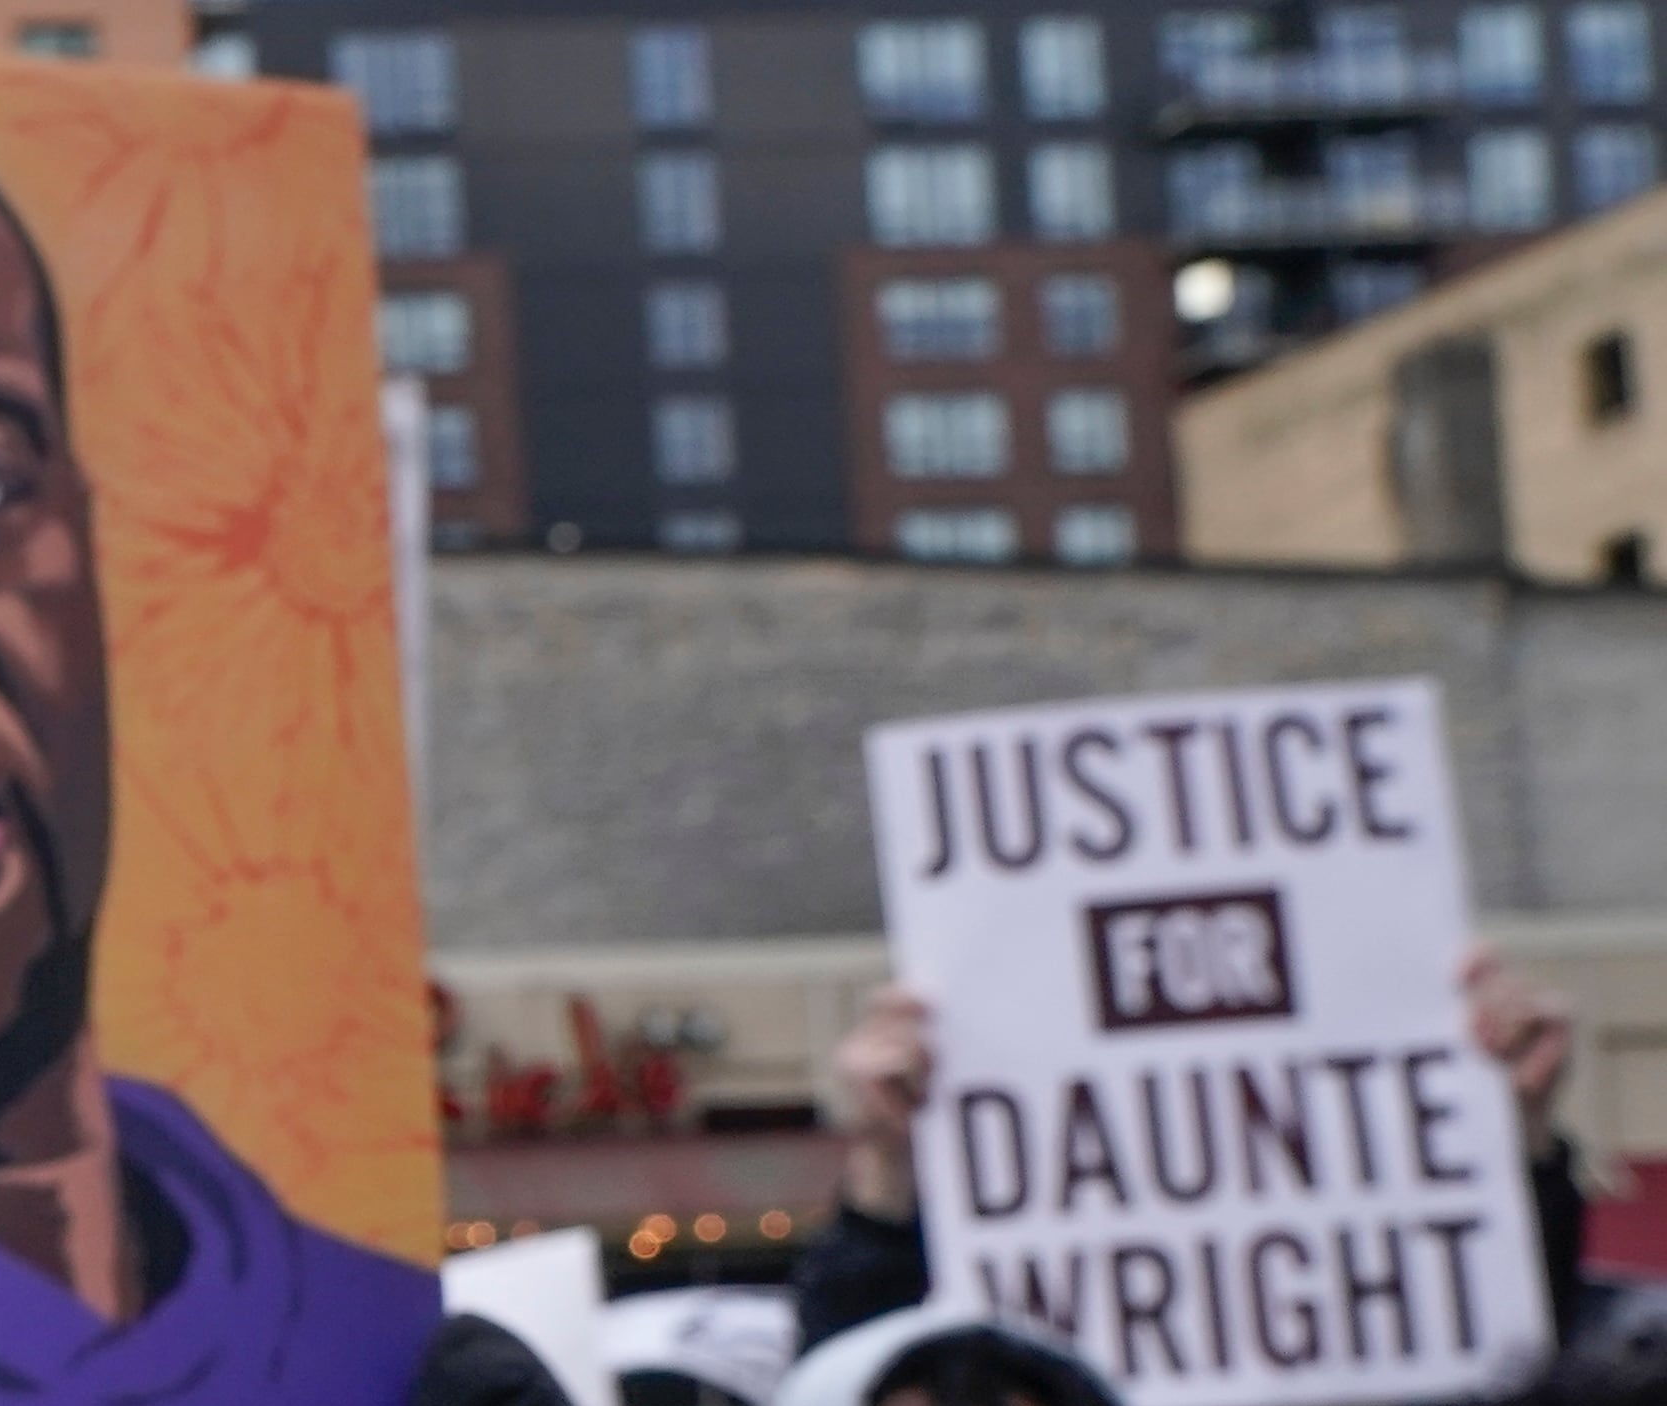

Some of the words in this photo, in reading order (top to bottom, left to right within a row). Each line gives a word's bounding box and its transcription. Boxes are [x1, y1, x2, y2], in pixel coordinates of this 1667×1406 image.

[919, 708, 1412, 880] JUSTICE
[1105, 898, 1279, 1020] FOR
[958, 1047, 1475, 1219] DAUNTE
